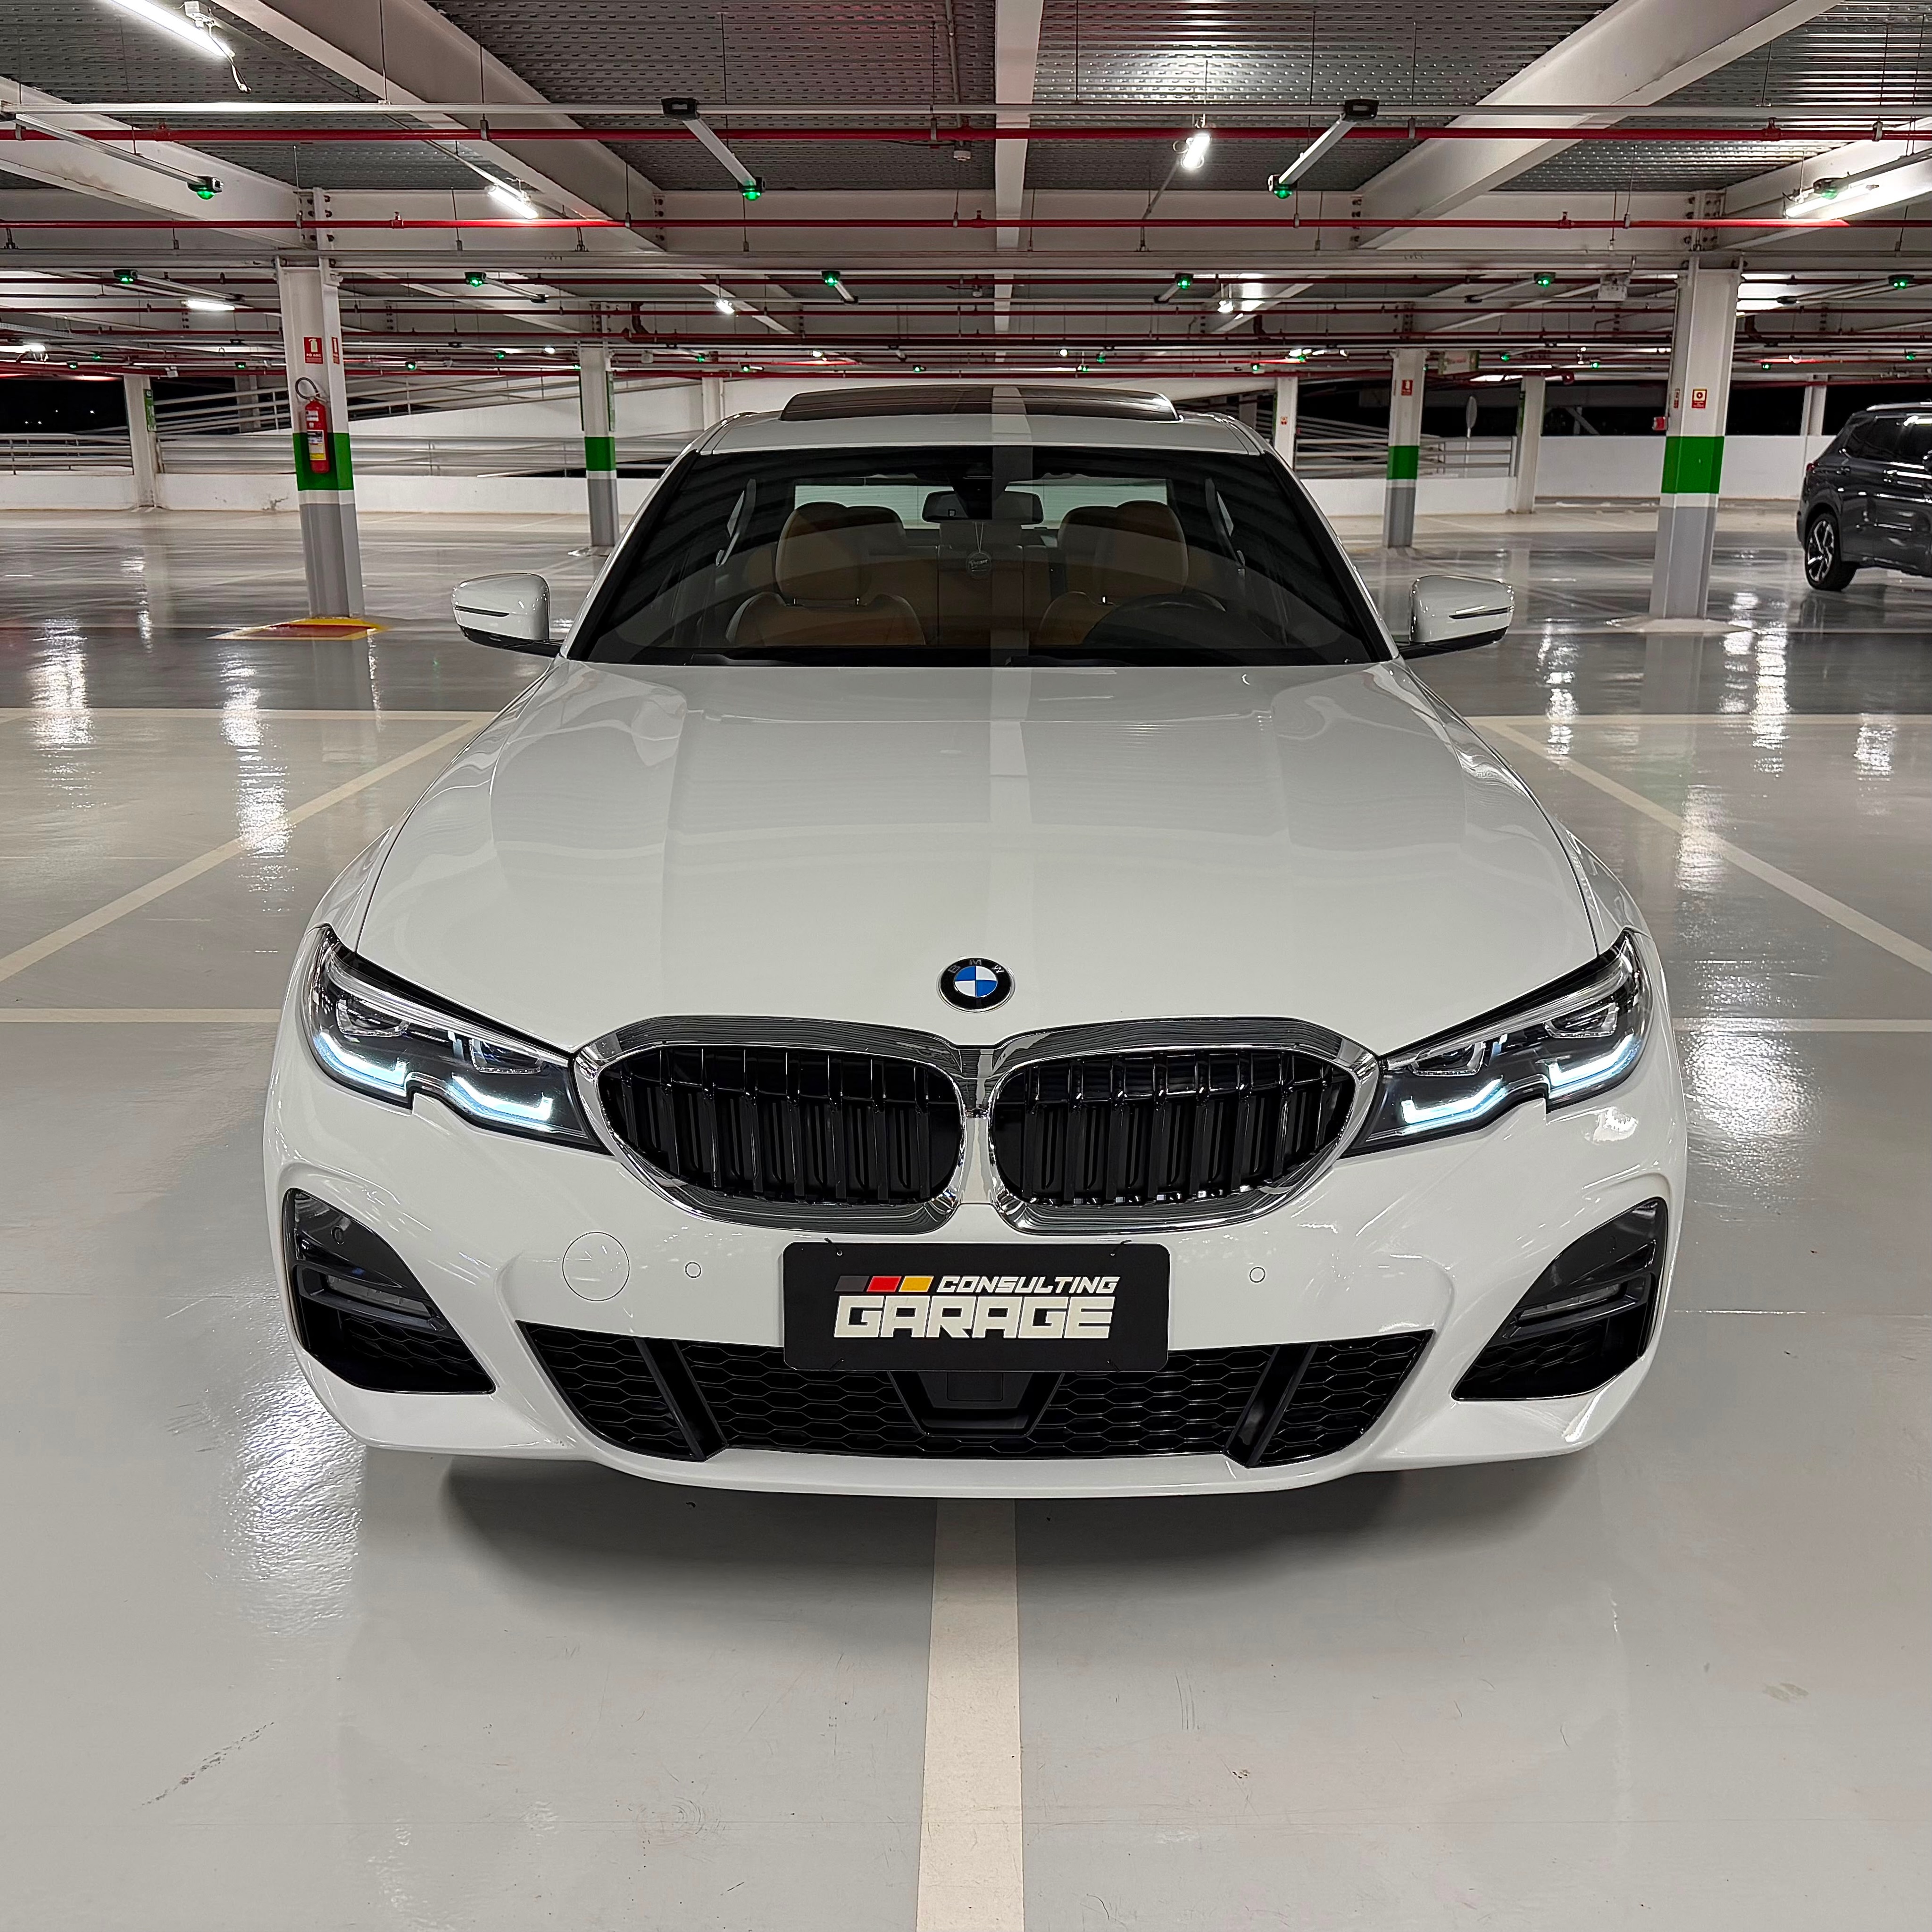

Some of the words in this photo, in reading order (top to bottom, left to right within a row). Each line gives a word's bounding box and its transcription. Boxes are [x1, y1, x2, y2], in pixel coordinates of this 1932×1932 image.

[947, 958, 1004, 974] BMW
[936, 1275, 1120, 1293] CONSULTING
[833, 1295, 1116, 1338] GARAGE
